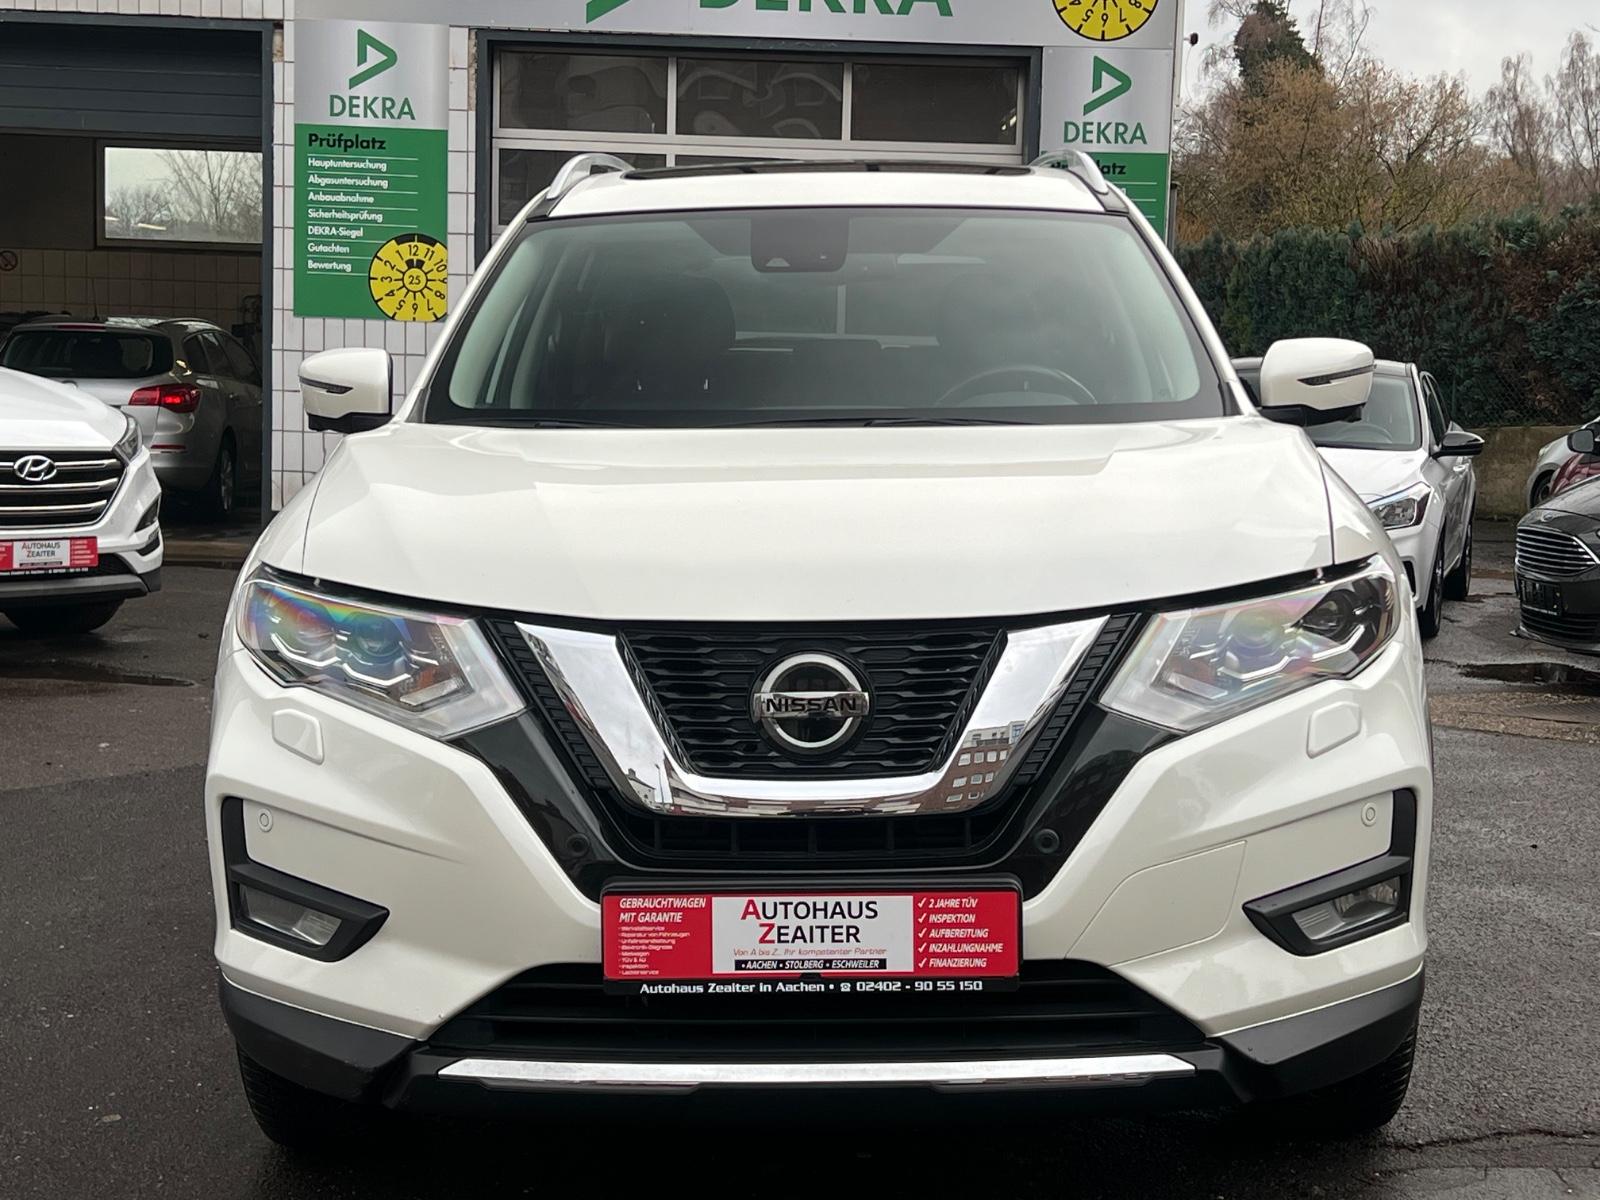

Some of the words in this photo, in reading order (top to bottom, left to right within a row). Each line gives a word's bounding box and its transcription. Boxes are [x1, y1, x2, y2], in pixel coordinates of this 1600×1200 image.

[329, 94, 416, 120] DEKRA
[1063, 121, 1147, 144] DEKRA
[308, 133, 386, 152] Prüfplatz
[308, 158, 387, 172] Hauptuntersuchung
[308, 174, 388, 189] Abgasuntersuchung
[308, 191, 374, 203] Anbauabnahme
[308, 208, 383, 222] Sicherheitsprüfung
[308, 226, 363, 238] DEKRA-Siegel
[308, 243, 350, 253] Gutachten
[408, 244, 419, 256] 12
[424, 248, 435, 261] 11
[308, 260, 352, 272] Bewertung
[408, 274, 421, 285] 25
[766, 697, 857, 712] NISSAN
[619, 897, 706, 909] GEBRAUCHTWAGEN
[928, 898, 934, 908] 2
[934, 898, 960, 908] JAHRE
[961, 896, 978, 908] TÜV
[740, 898, 878, 920] AUTOHAUS
[619, 912, 637, 922] MIT
[638, 912, 683, 922] GARANTIE
[928, 913, 976, 923] INSPEKTION
[758, 922, 861, 945] ZEAITER
[928, 928, 989, 938] AUFBEREITUNG
[854, 947, 887, 956] Partner
[928, 943, 1004, 953] INZAHLUNGNAHME
[746, 960, 777, 969] AACHEN
[785, 960, 824, 969] STOLBERG
[831, 960, 880, 969] ESCHWEILER
[928, 958, 988, 968] FINANZIERUNG
[640, 983, 703, 994] Autohaus
[707, 982, 756, 993] Zeaiter
[759, 982, 772, 992] in
[775, 982, 825, 992] Aachen
[856, 981, 901, 991] 02402
[914, 981, 933, 991] 90
[937, 981, 955, 991] 55
[959, 981, 983, 991] 150
